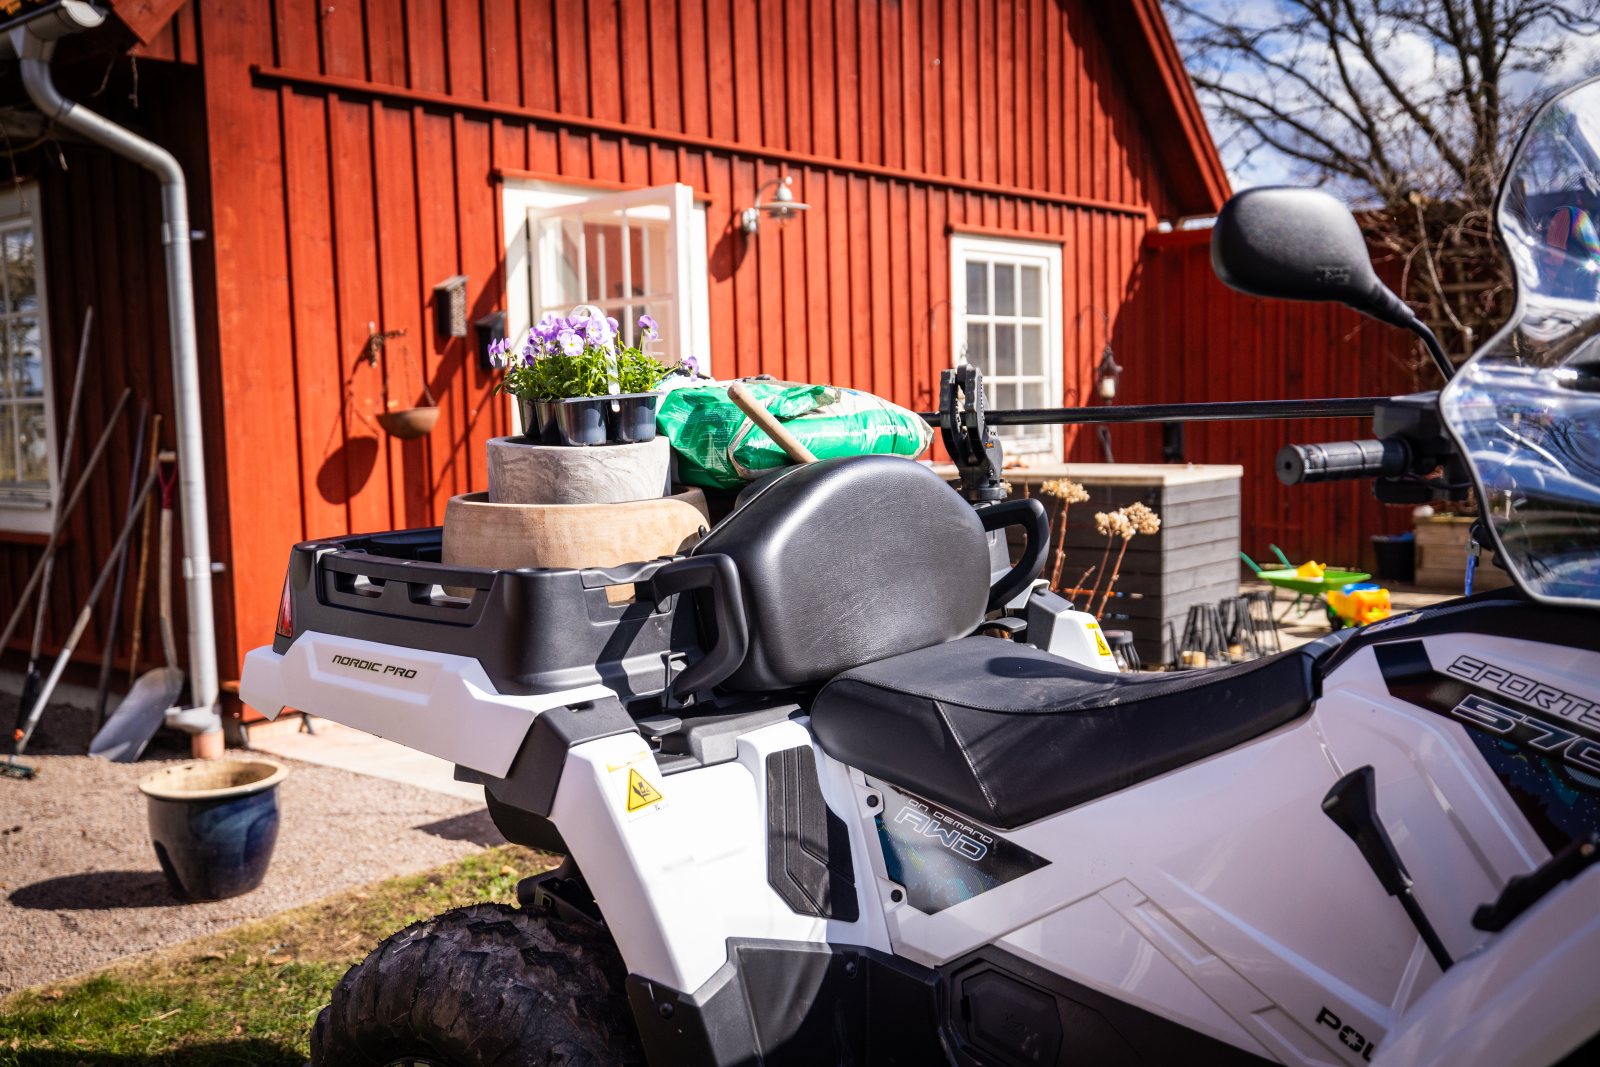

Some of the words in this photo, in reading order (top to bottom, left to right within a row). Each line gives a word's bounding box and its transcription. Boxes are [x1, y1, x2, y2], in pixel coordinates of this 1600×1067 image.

[332, 654, 382, 672] NORDIC
[383, 665, 417, 679] PRO
[894, 806, 988, 861] AWD
[908, 798, 929, 812] ON
[933, 811, 993, 844] DEMAND
